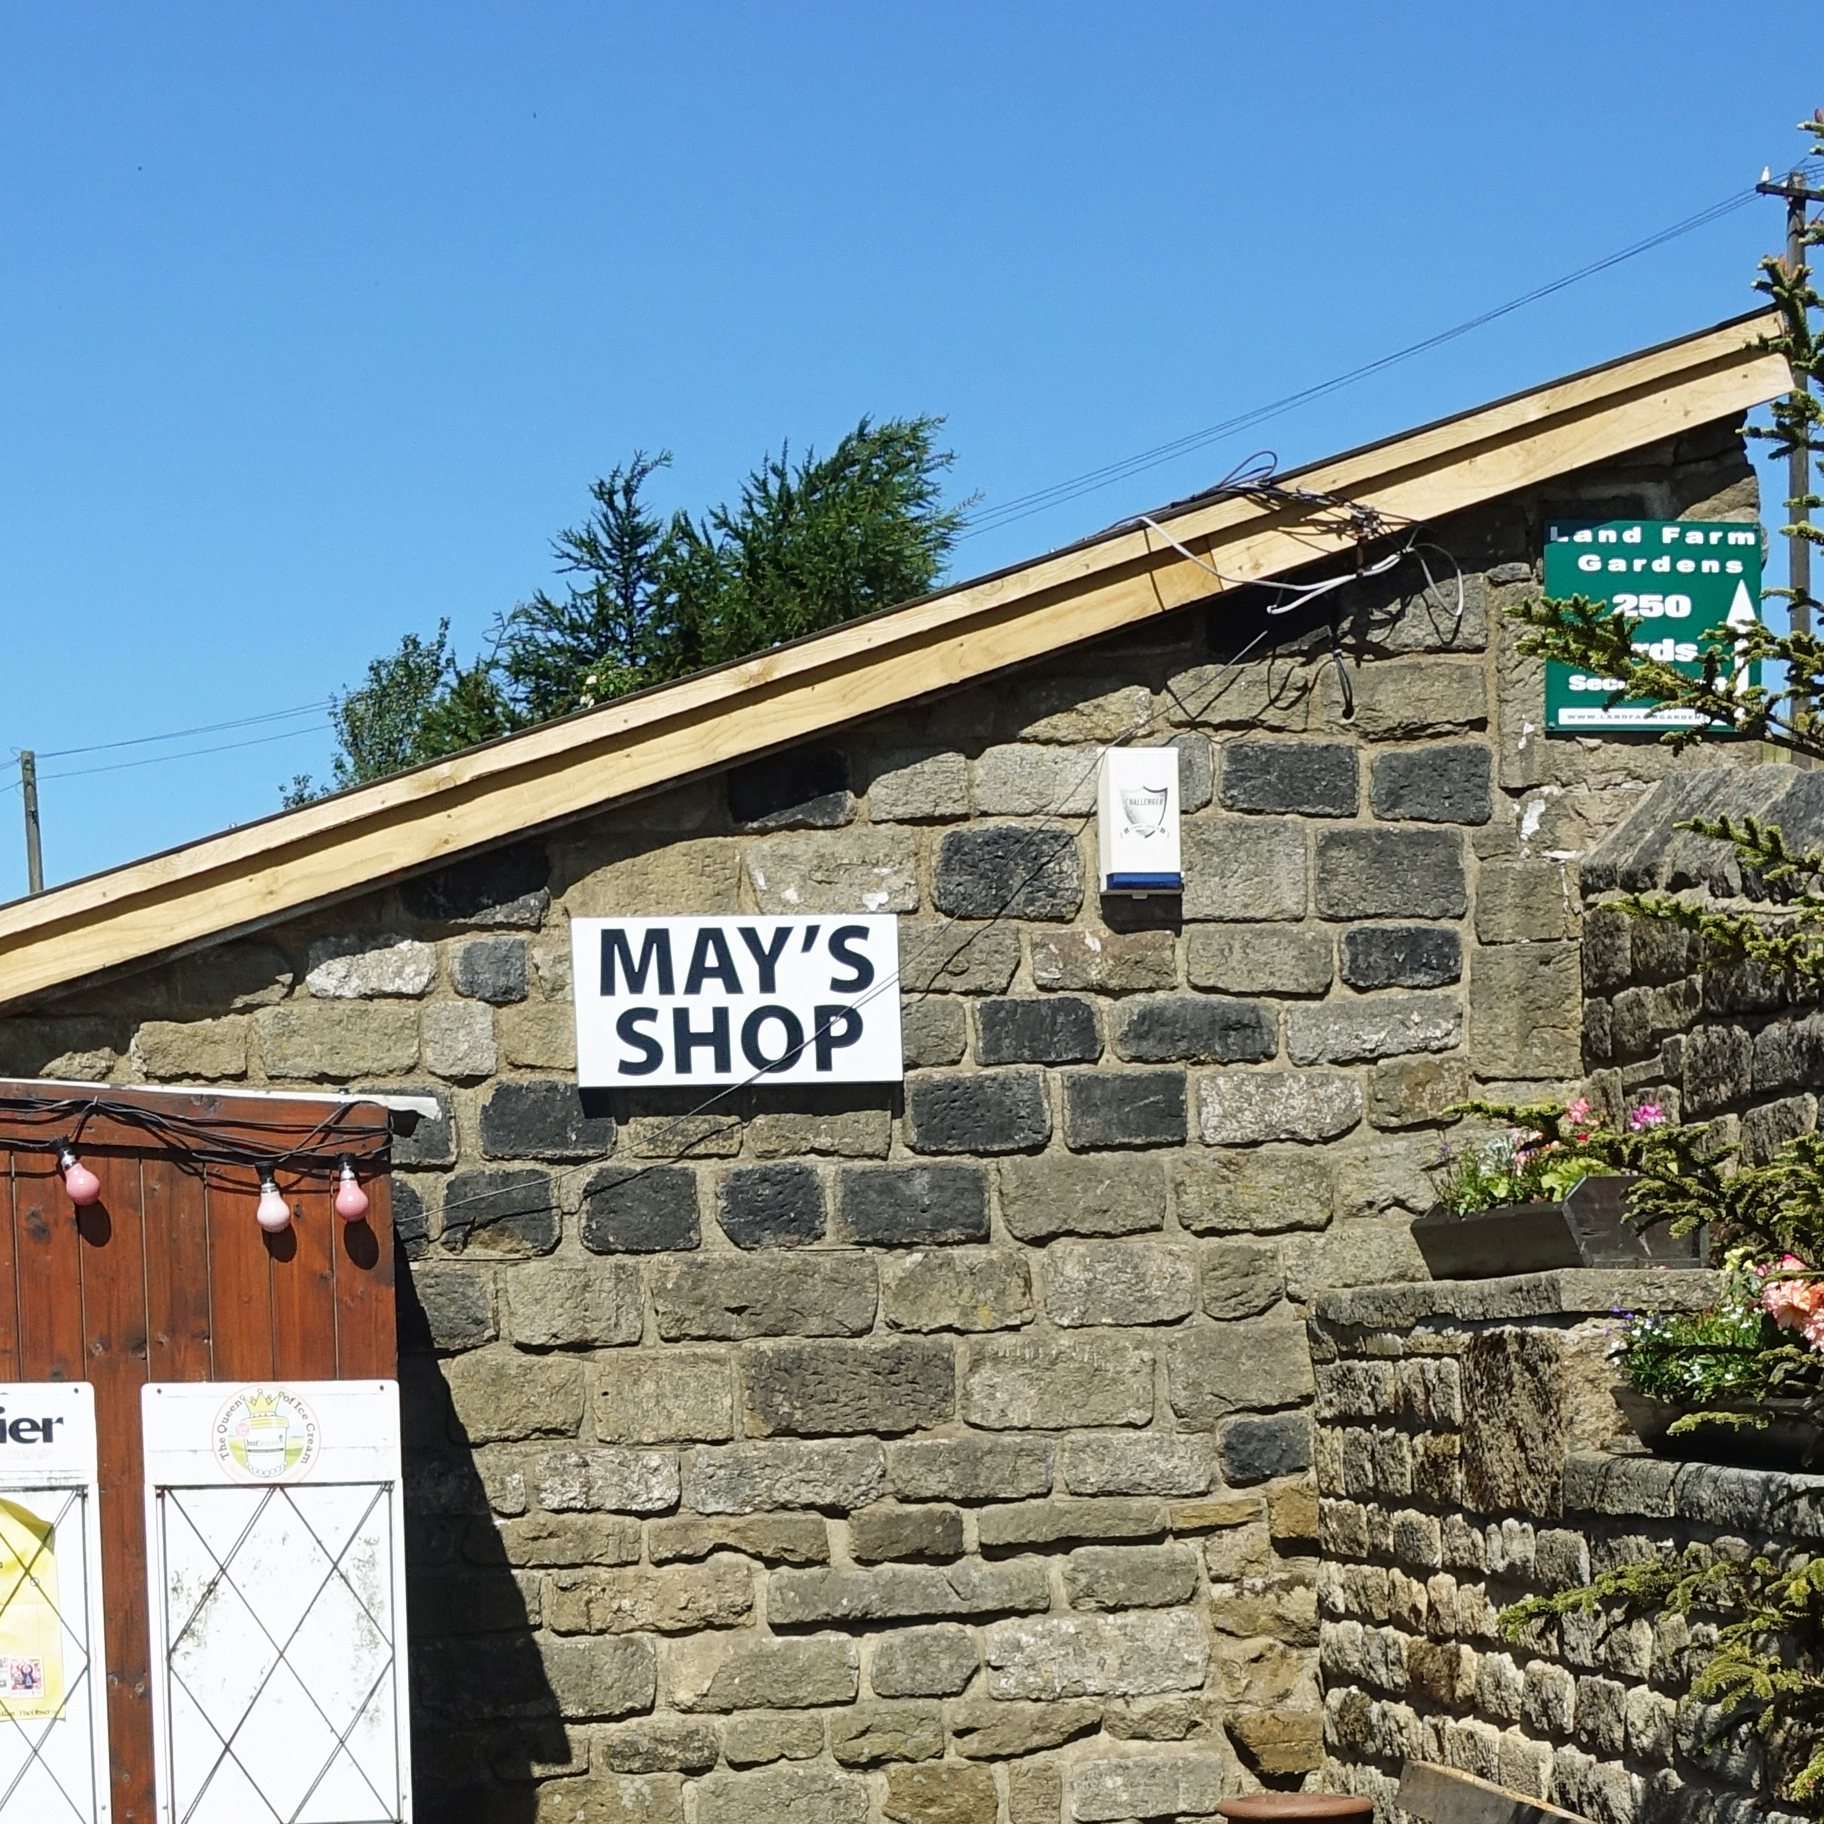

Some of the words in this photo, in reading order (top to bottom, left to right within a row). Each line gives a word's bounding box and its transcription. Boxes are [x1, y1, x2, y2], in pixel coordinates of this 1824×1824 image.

[1550, 526, 1642, 543] Land
[1661, 526, 1756, 545] Farm
[1577, 554, 1744, 573] Gardens
[1612, 593, 1692, 618] 250
[599, 923, 875, 997] MAY'S
[616, 1004, 864, 1077] SHOP
[283, 1395, 296, 1405] of
[293, 1401, 309, 1421] Ice
[217, 1400, 243, 1434] Queen
[218, 1437, 230, 1461] The
[301, 1423, 316, 1465] Cream
